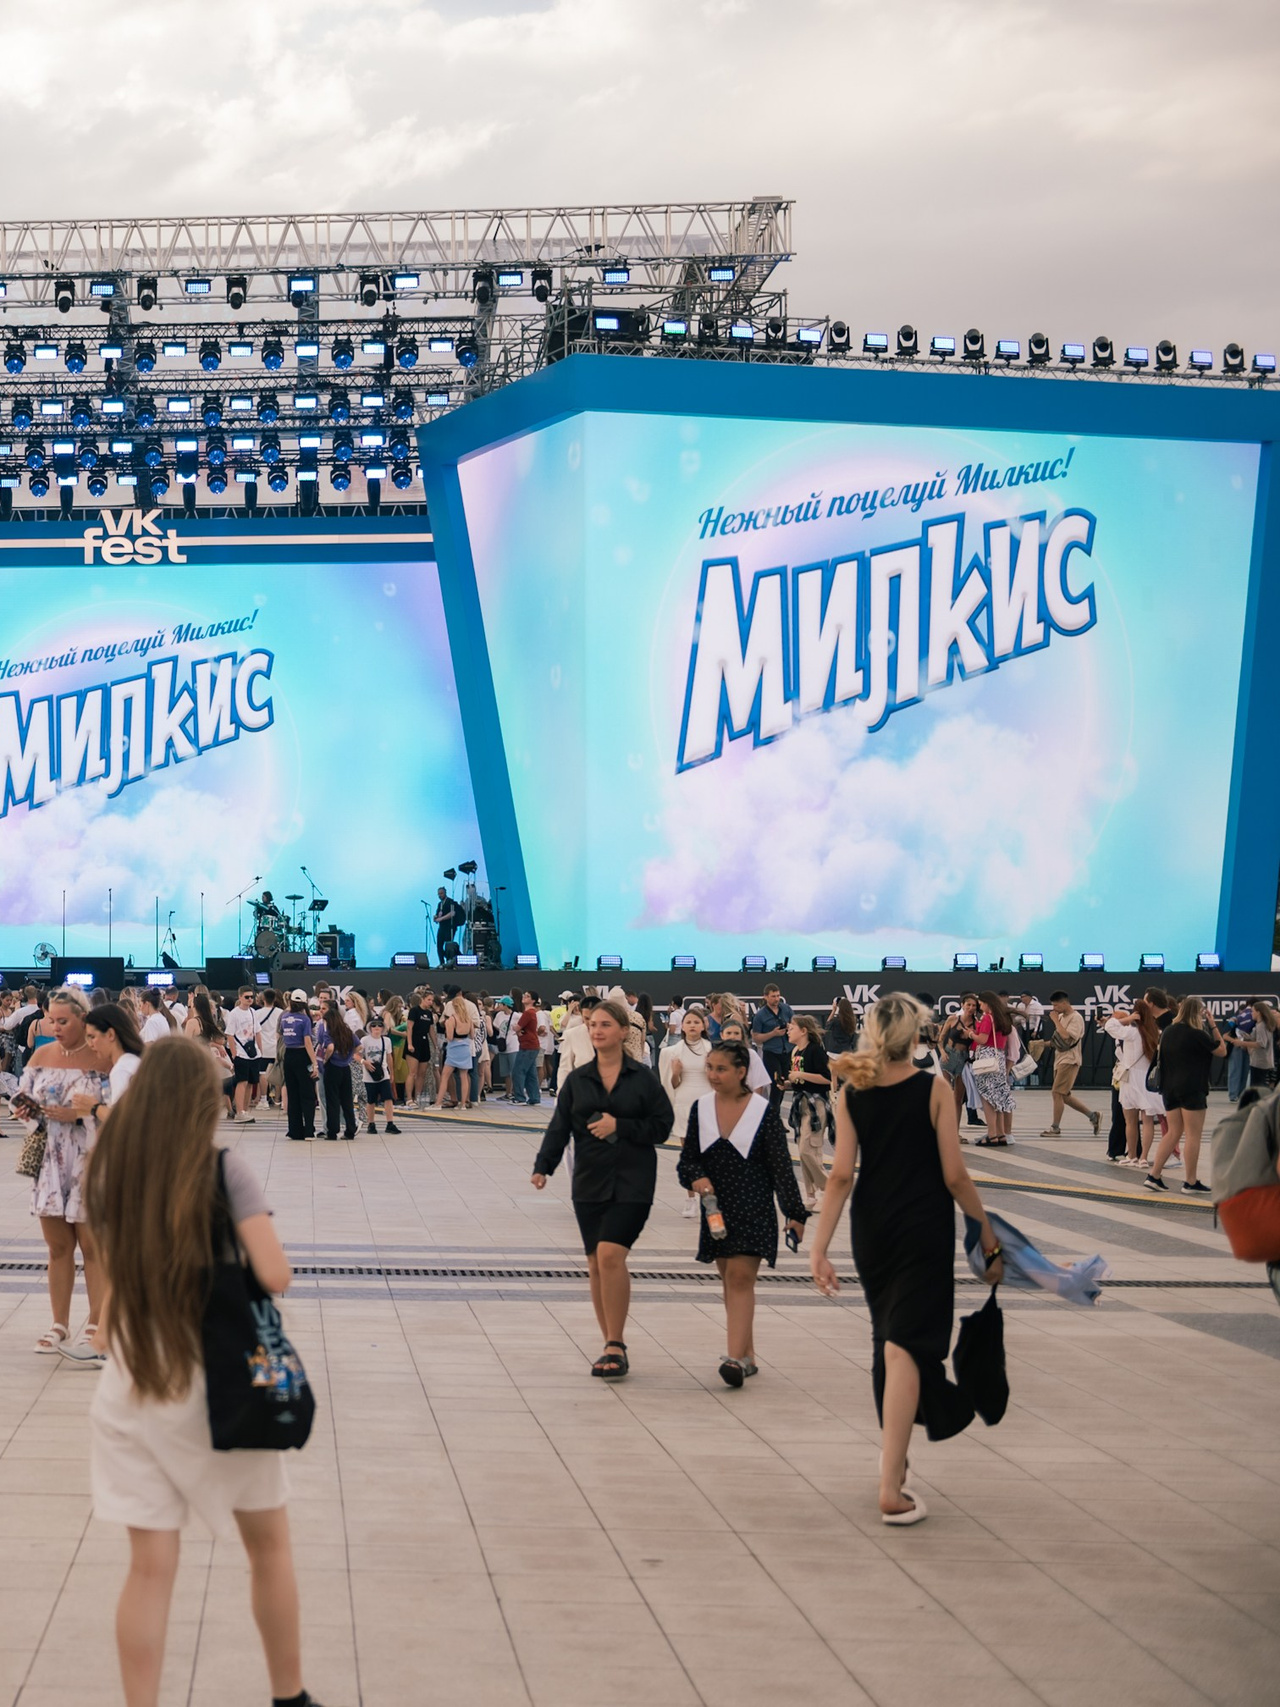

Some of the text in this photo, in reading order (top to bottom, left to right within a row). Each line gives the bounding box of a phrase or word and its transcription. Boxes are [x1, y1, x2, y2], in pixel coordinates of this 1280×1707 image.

[698, 447, 1075, 540] Нежный поцелуй Милкис!
[100, 509, 163, 535] VK
[84, 527, 187, 565] fest
[80, 630, 165, 664] поцелуй
[171, 609, 259, 645] Милкис!
[842, 984, 881, 1003] VK
[1094, 985, 1131, 1003] VK
